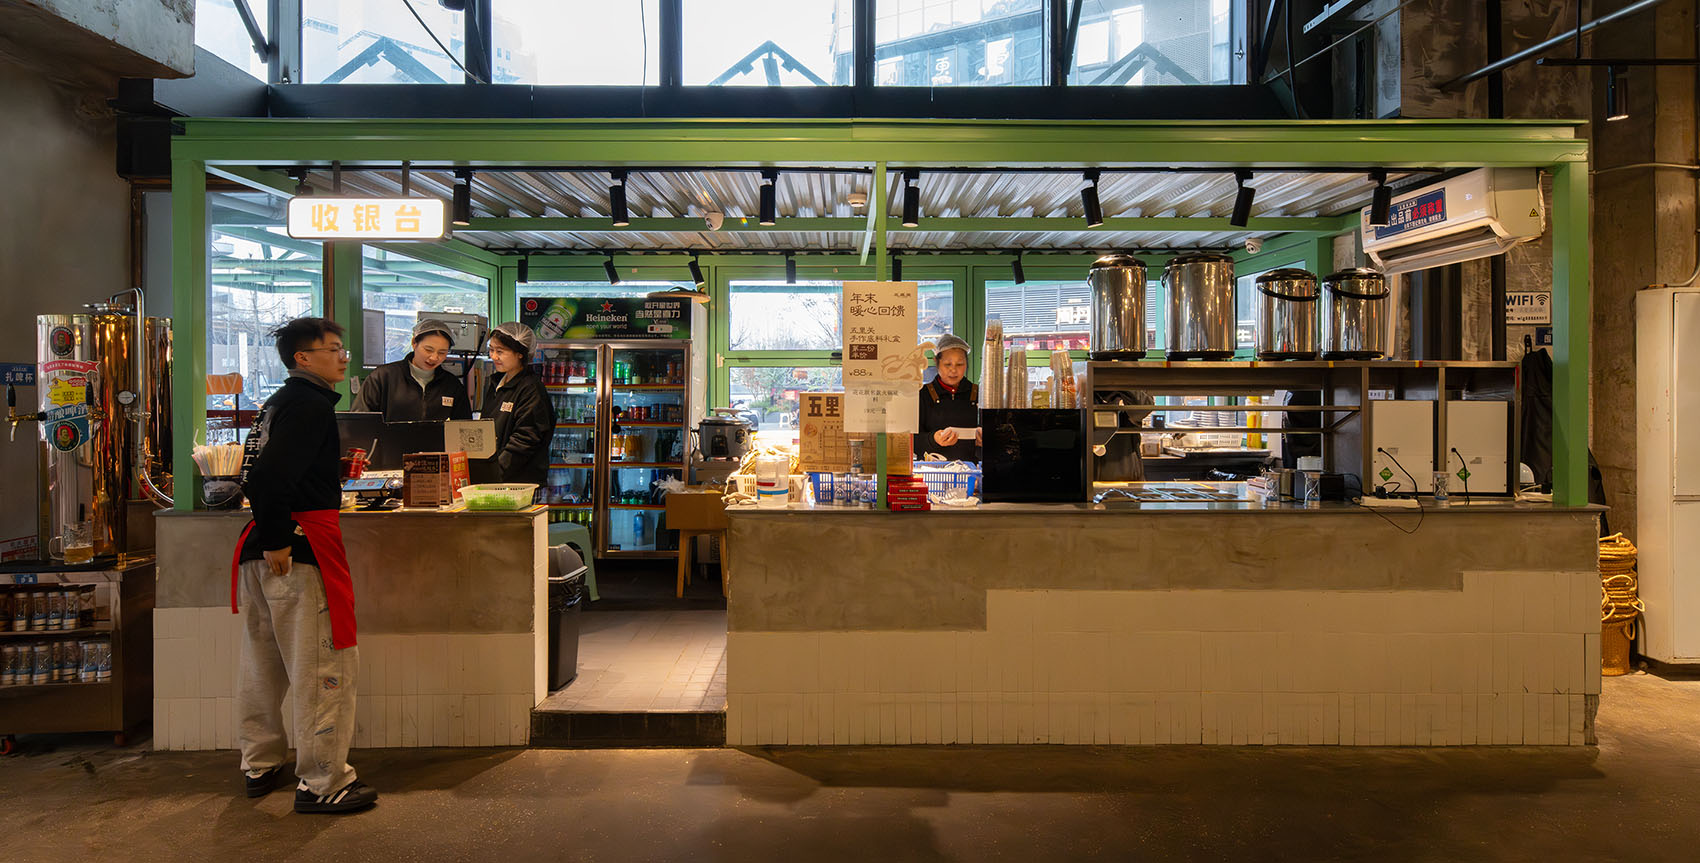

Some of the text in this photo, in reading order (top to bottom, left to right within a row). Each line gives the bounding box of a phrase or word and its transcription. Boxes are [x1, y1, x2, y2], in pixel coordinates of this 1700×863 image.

[311, 204, 421, 232] 收银台
[850, 292, 878, 304] 年末
[1505, 295, 1533, 305] WIFI
[850, 304, 905, 317] 暖心回馈
[586, 314, 627, 322] Heineken
[807, 396, 840, 417] 五里
